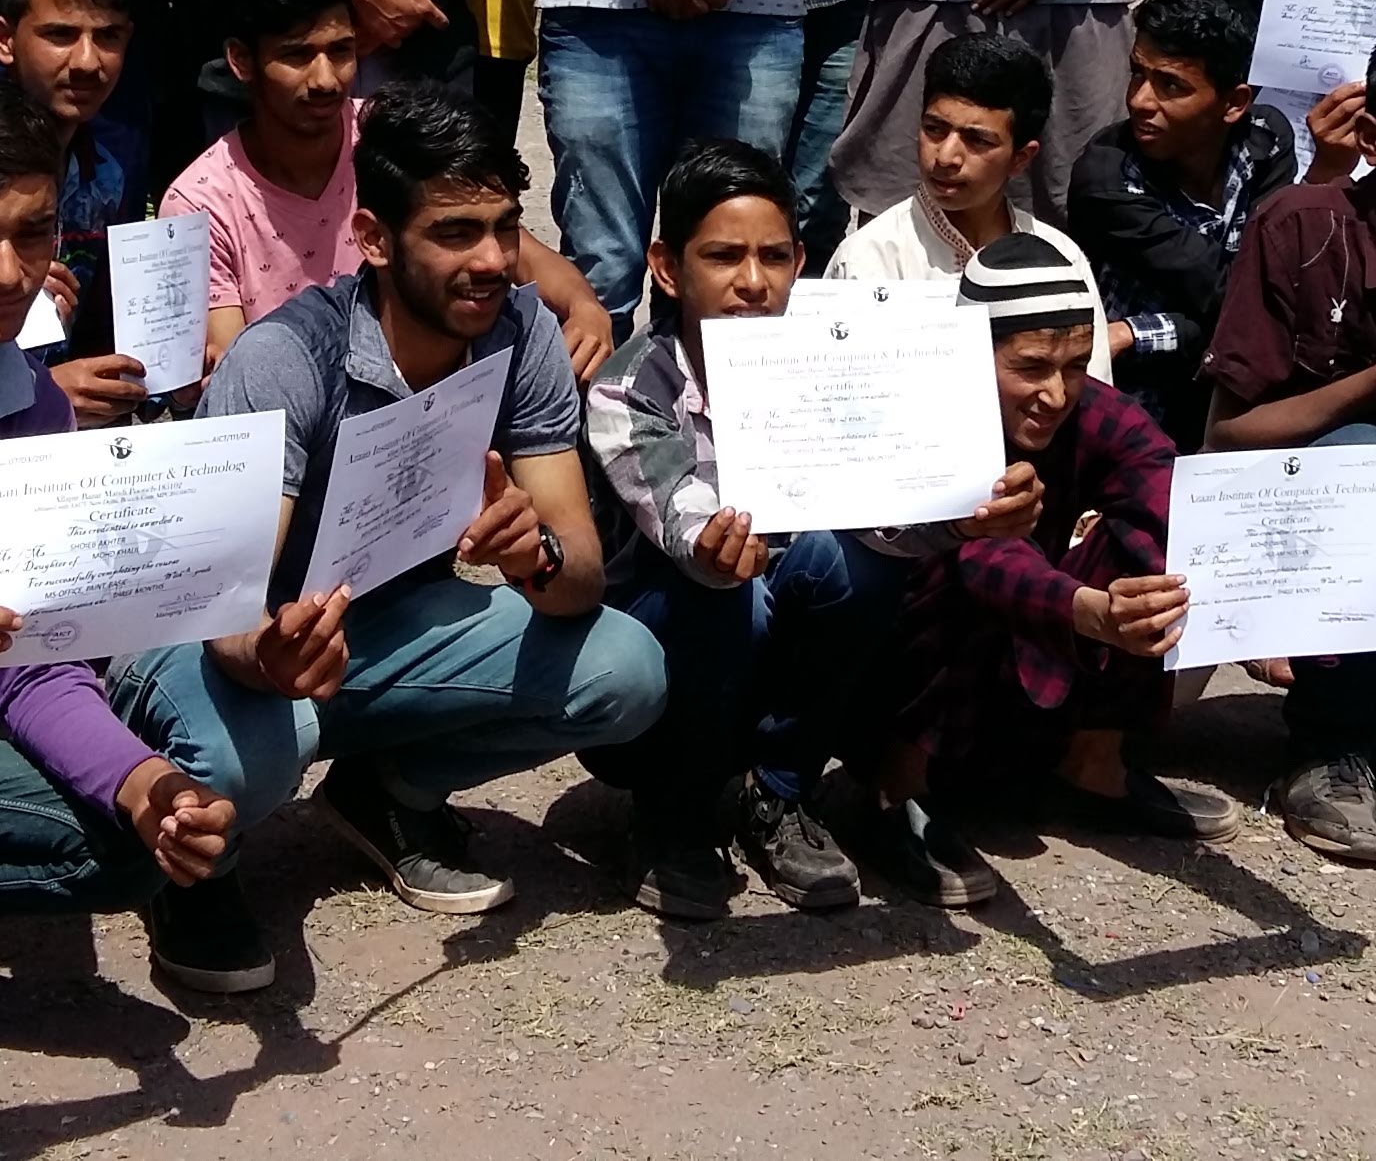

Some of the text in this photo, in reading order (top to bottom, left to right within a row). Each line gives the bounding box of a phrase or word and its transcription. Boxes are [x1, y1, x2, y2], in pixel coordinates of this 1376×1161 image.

[23, 482, 72, 496] Institute
[80, 477, 96, 488] Of
[102, 472, 162, 487] Computer
[167, 467, 176, 479] &
[183, 459, 246, 478] Technology
[1258, 488, 1271, 498] Of
[89, 506, 155, 522] Certificate
